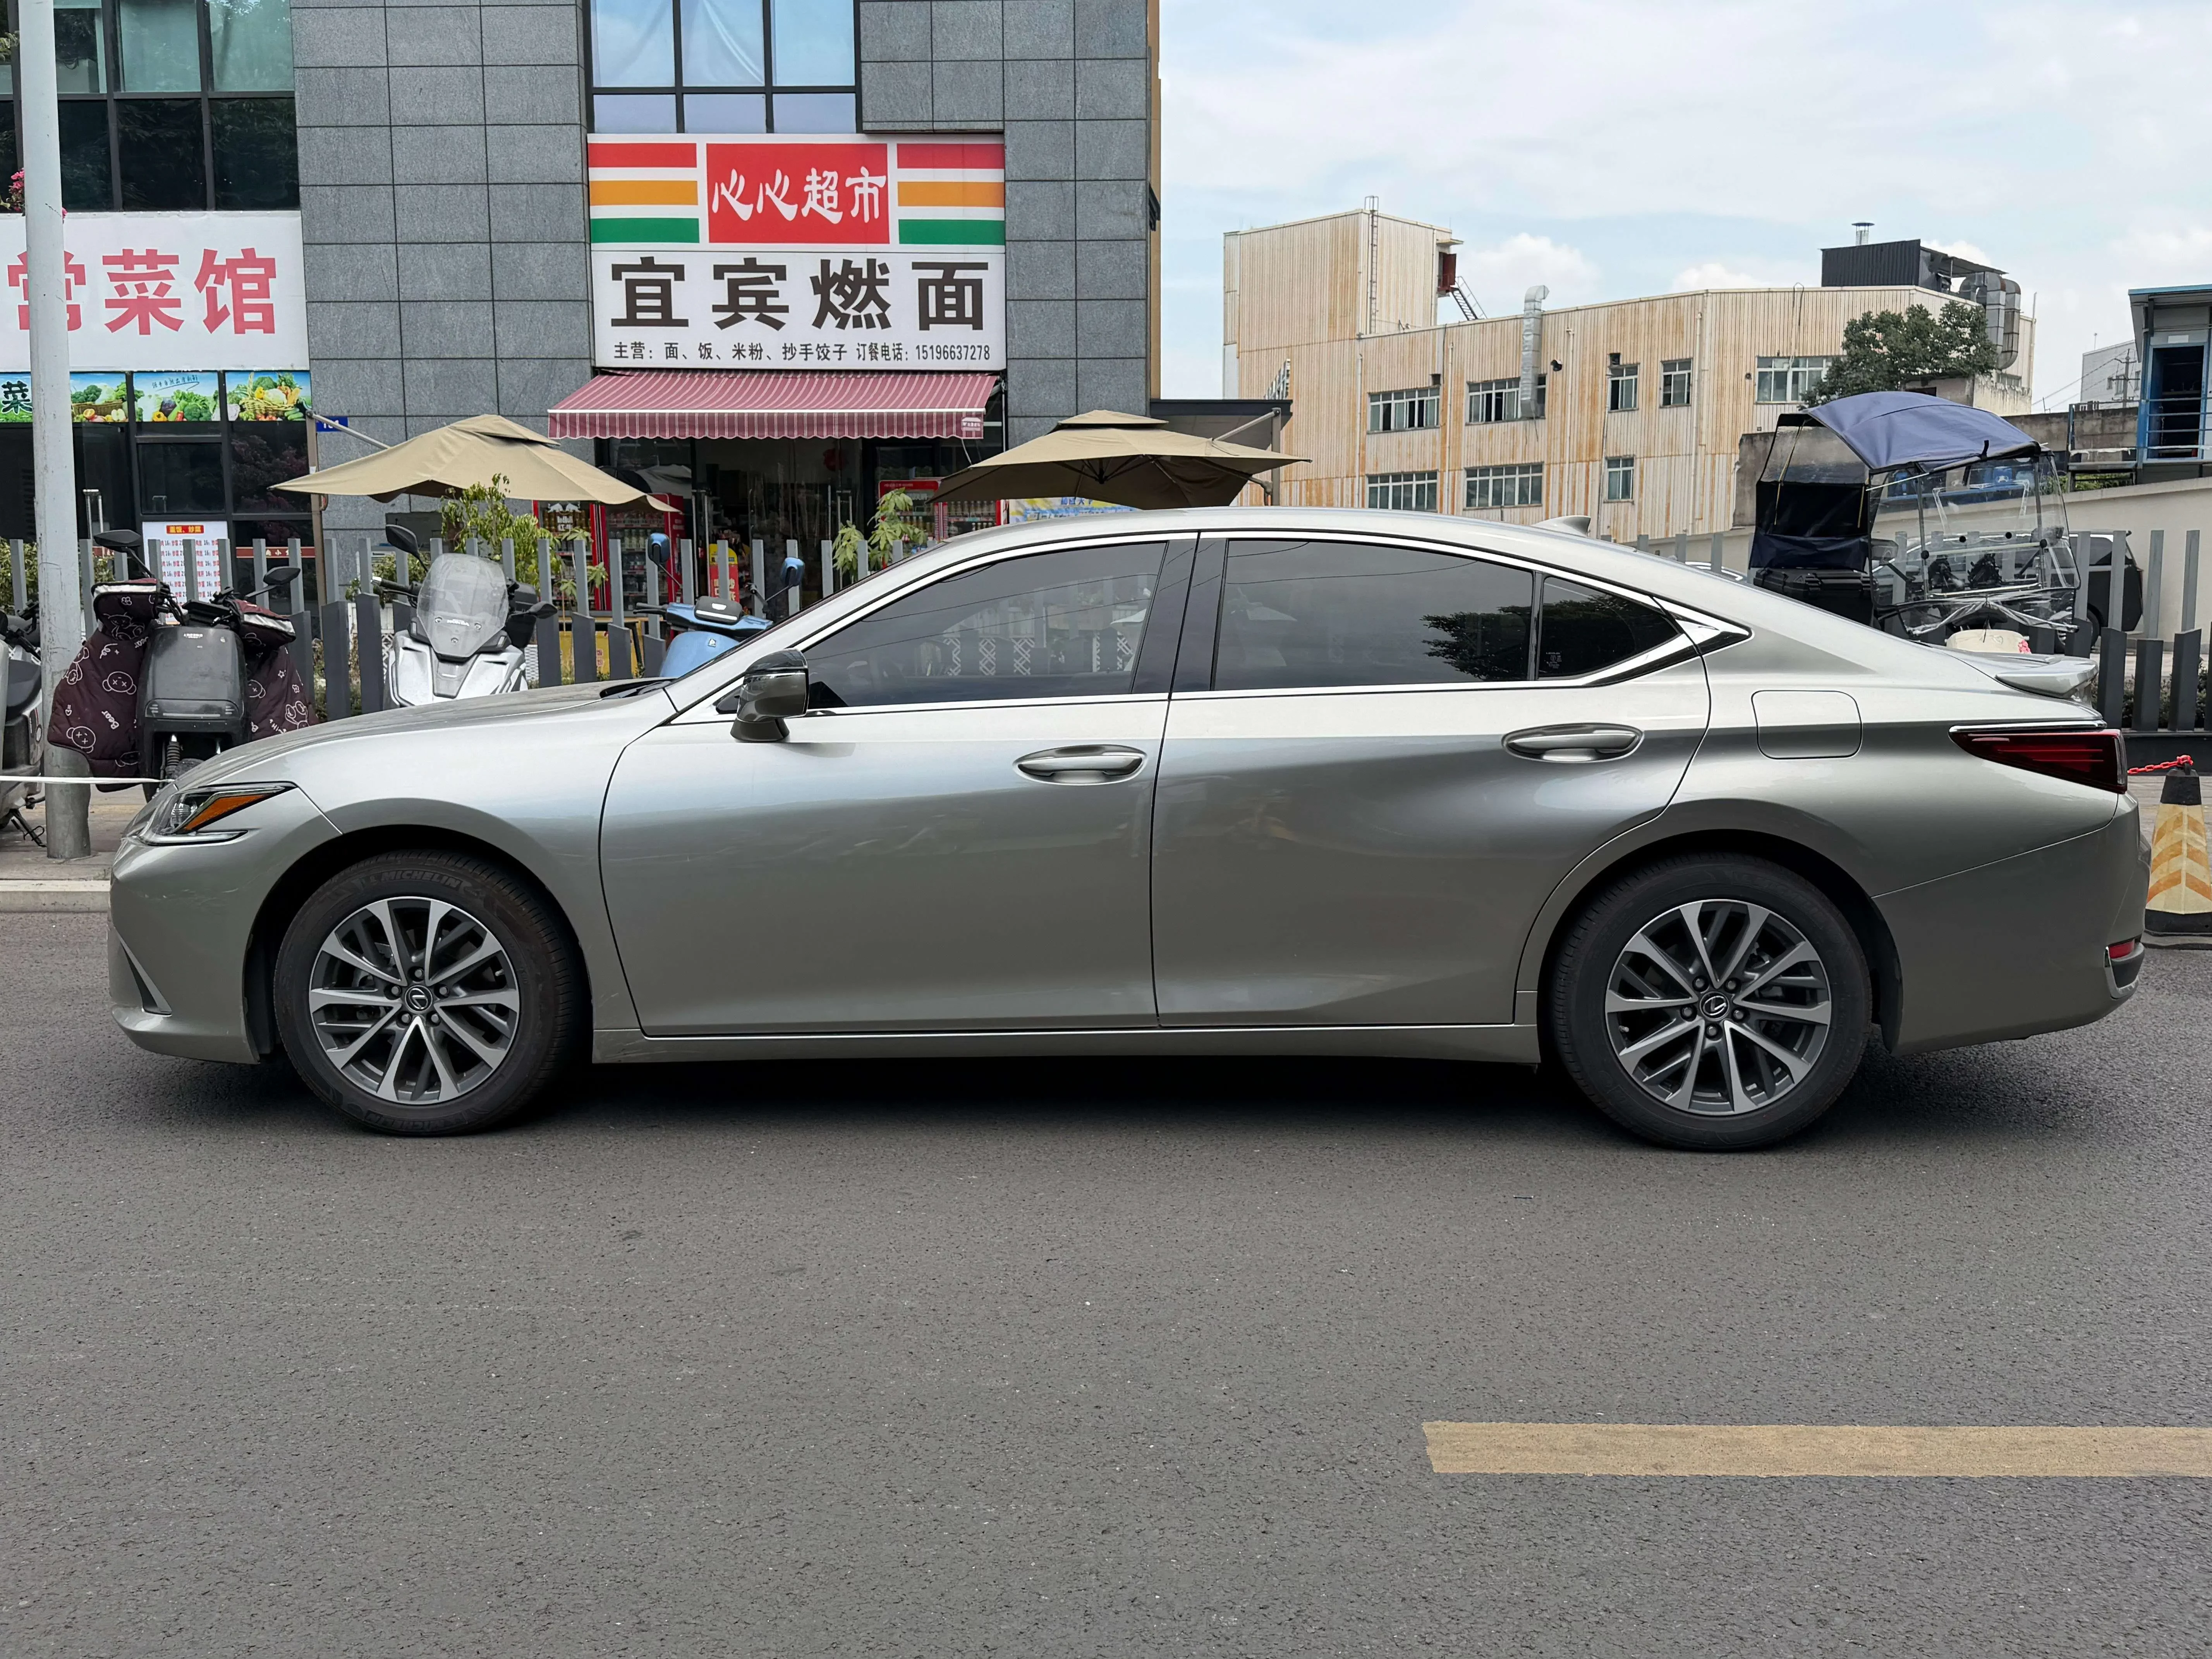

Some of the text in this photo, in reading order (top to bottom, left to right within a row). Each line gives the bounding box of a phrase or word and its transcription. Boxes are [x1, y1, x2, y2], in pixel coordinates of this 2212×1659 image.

[712, 167, 887, 224] 心心超市
[611, 256, 989, 331] 宜宾燃面
[1, 380, 33, 414] 菜
[101, 710, 120, 730] Bear
[381, 869, 460, 888] MICHELIN
